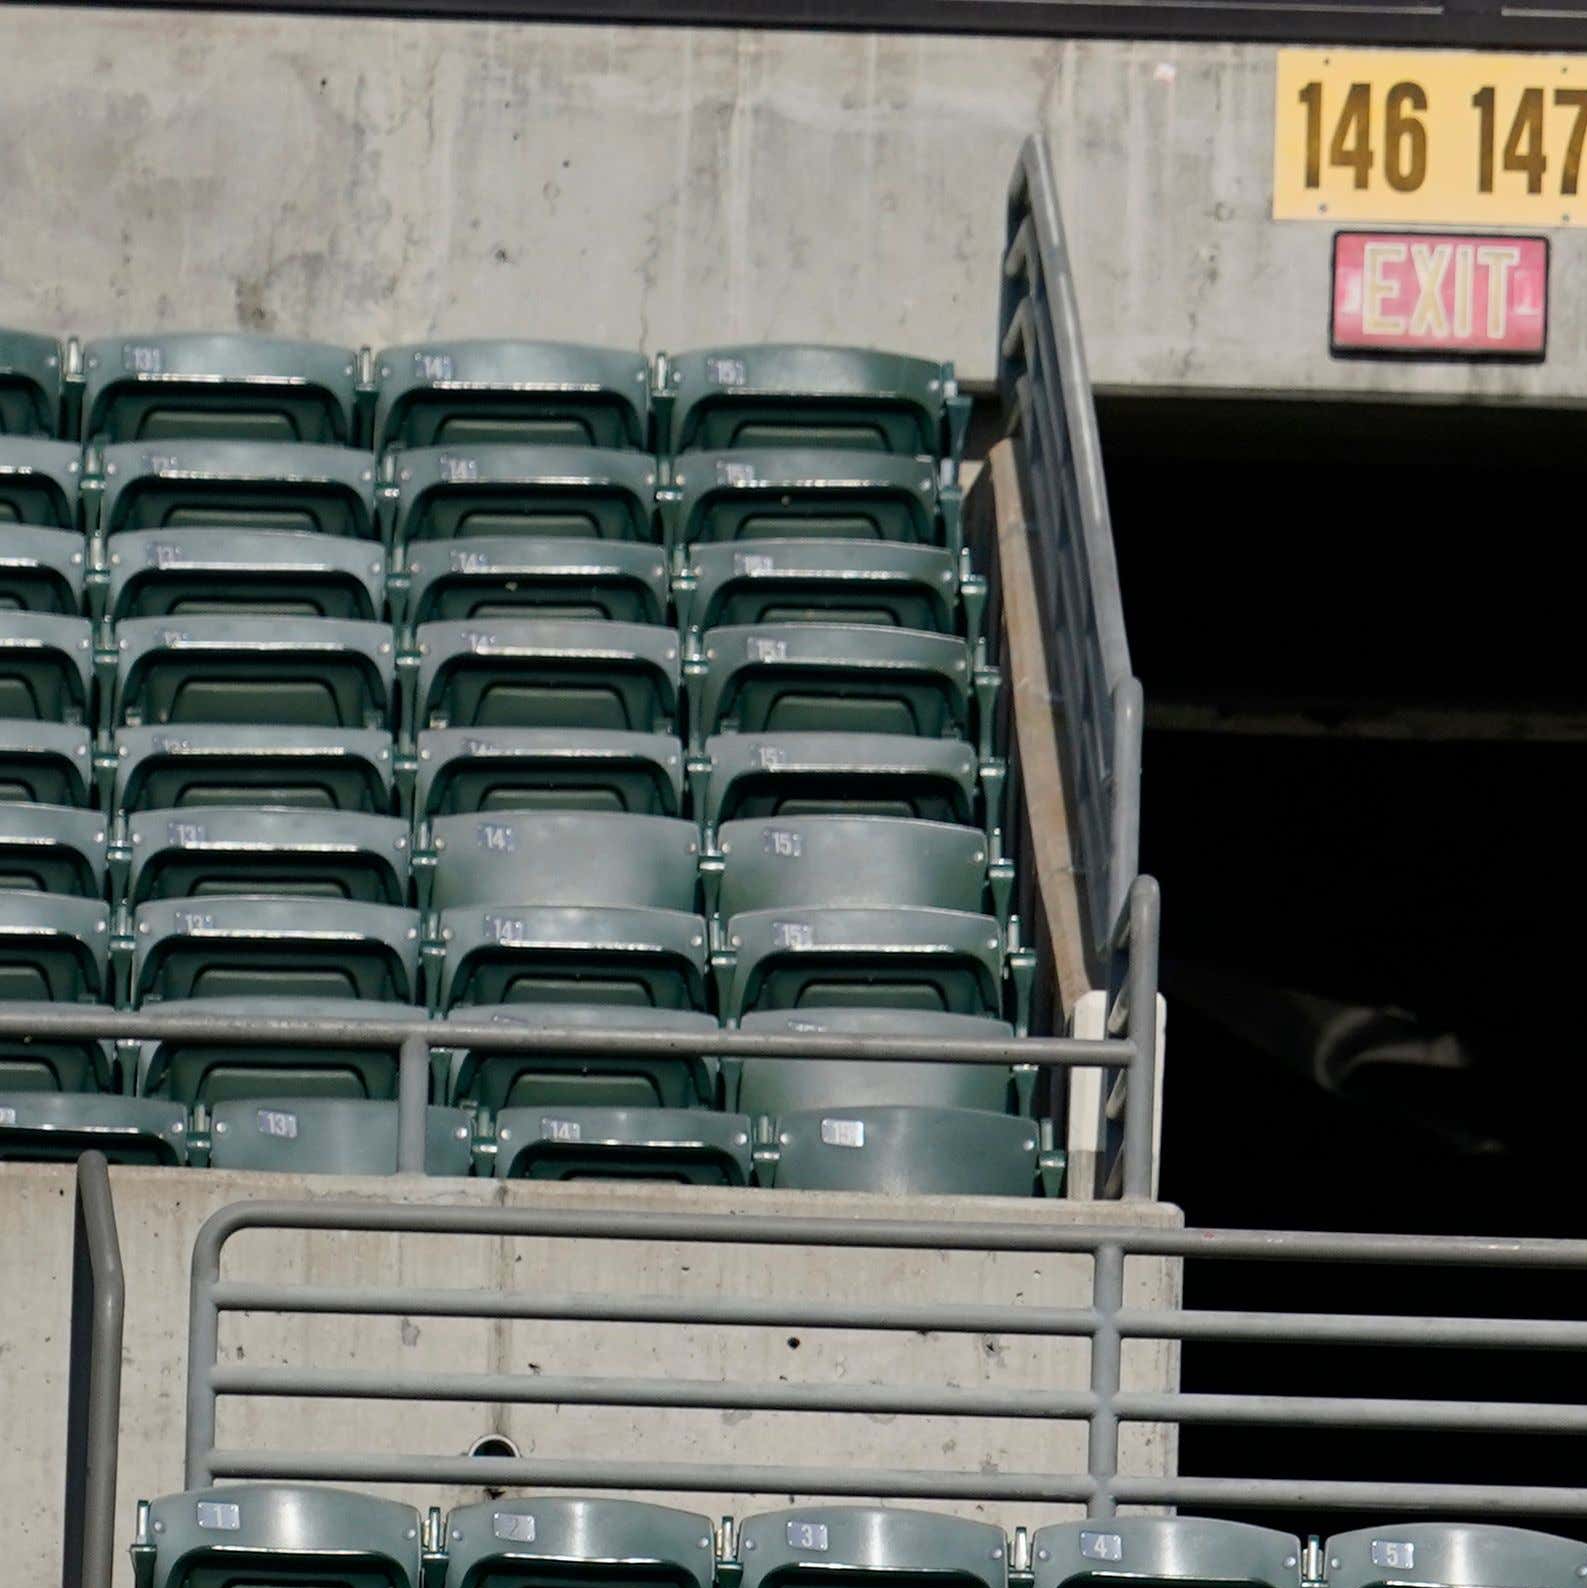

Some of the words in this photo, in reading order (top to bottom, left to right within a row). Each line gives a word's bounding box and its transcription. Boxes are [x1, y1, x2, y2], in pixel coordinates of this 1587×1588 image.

[1299, 82, 1428, 193] 146
[1362, 241, 1520, 338] EXIT
[214, 1506, 223, 1523] 1
[511, 1515, 520, 1533] 2
[801, 1525, 812, 1547] 3
[1094, 1535, 1107, 1556] 4
[1386, 1546, 1398, 1566] 5
